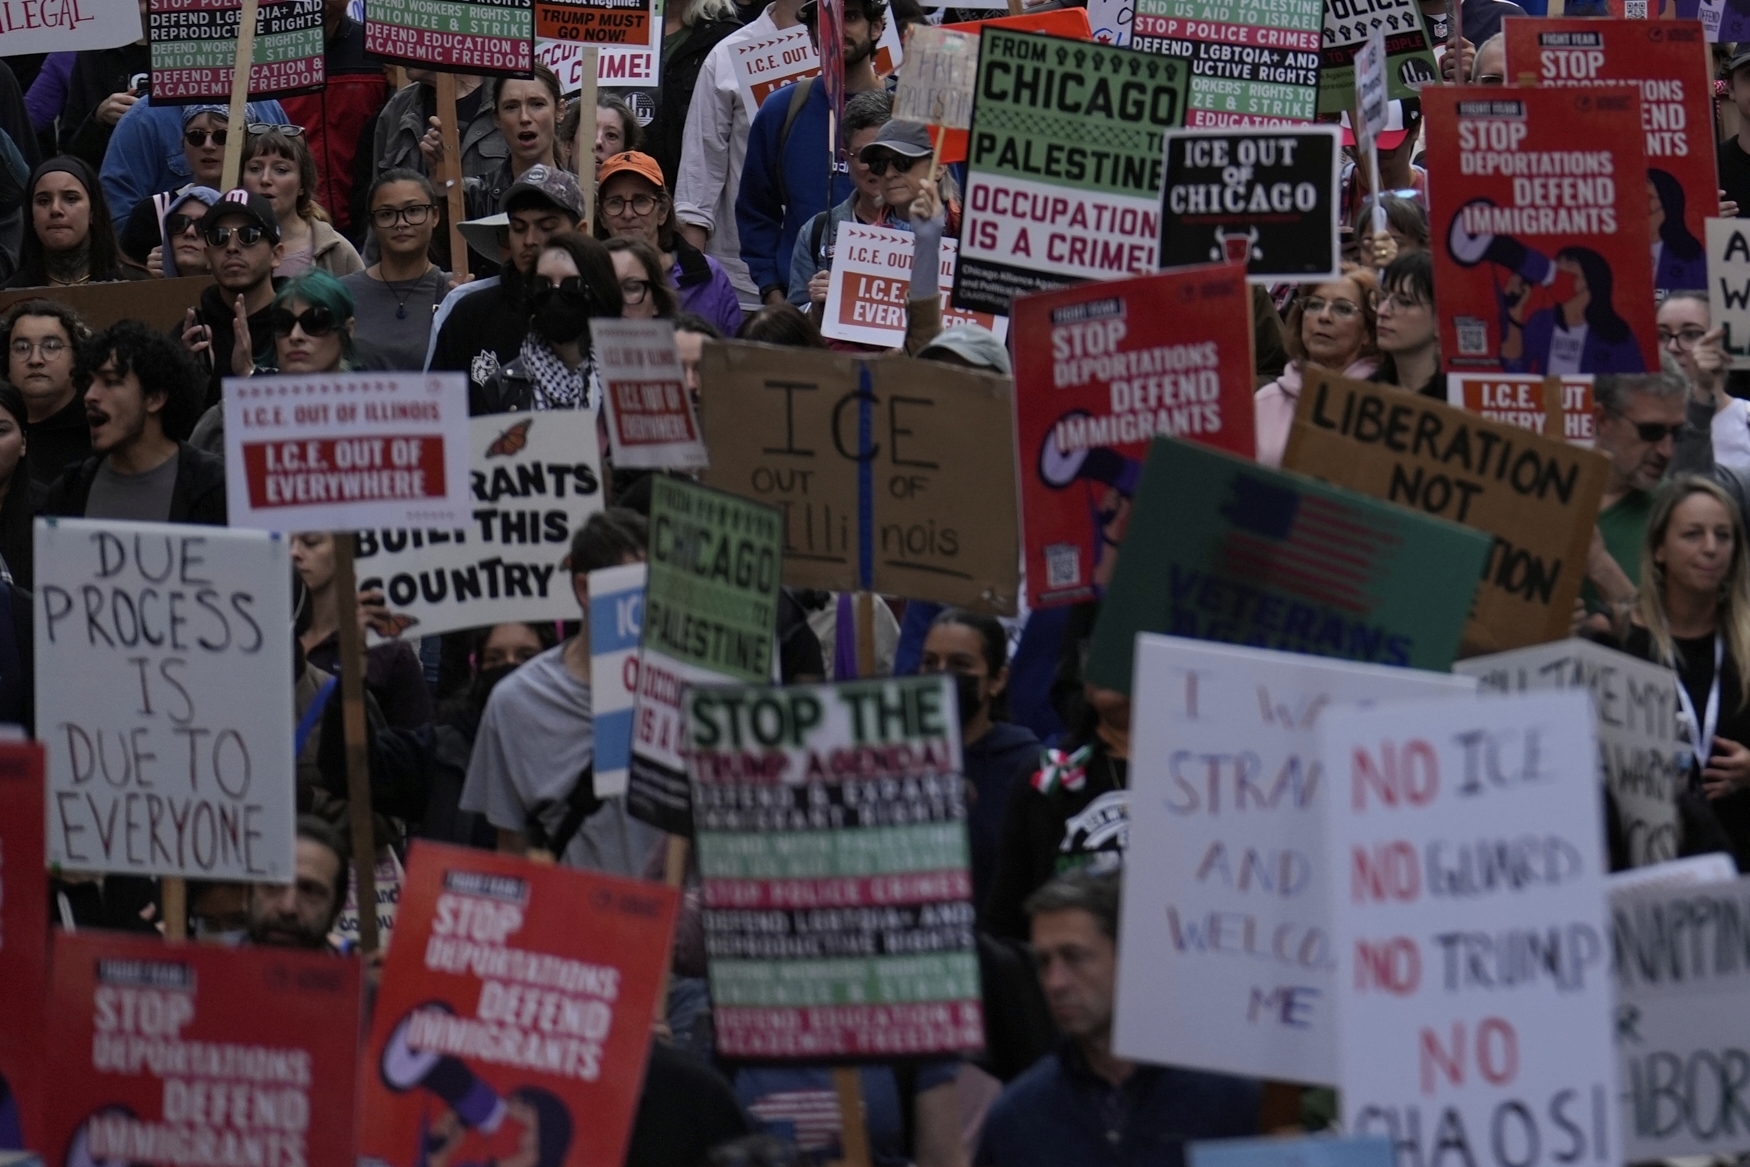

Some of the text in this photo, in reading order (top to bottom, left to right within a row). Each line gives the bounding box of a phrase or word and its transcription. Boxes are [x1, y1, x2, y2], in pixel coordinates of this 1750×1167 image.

[762, 379, 940, 471] ICE
[1312, 382, 1580, 505] LIBERATION
[751, 466, 930, 499] OUT OF
[1388, 461, 1483, 522] NOT
[91, 532, 212, 585] DUE
[43, 584, 263, 654] PROCESS
[127, 656, 195, 727] IS
[57, 722, 252, 801] DUE TO
[1351, 738, 1441, 813] NO
[56, 791, 267, 875] EVERYONE
[1351, 839, 1422, 905] NO
[1353, 922, 1603, 996] NO TRUMP
[1418, 1016, 1521, 1096] NO
